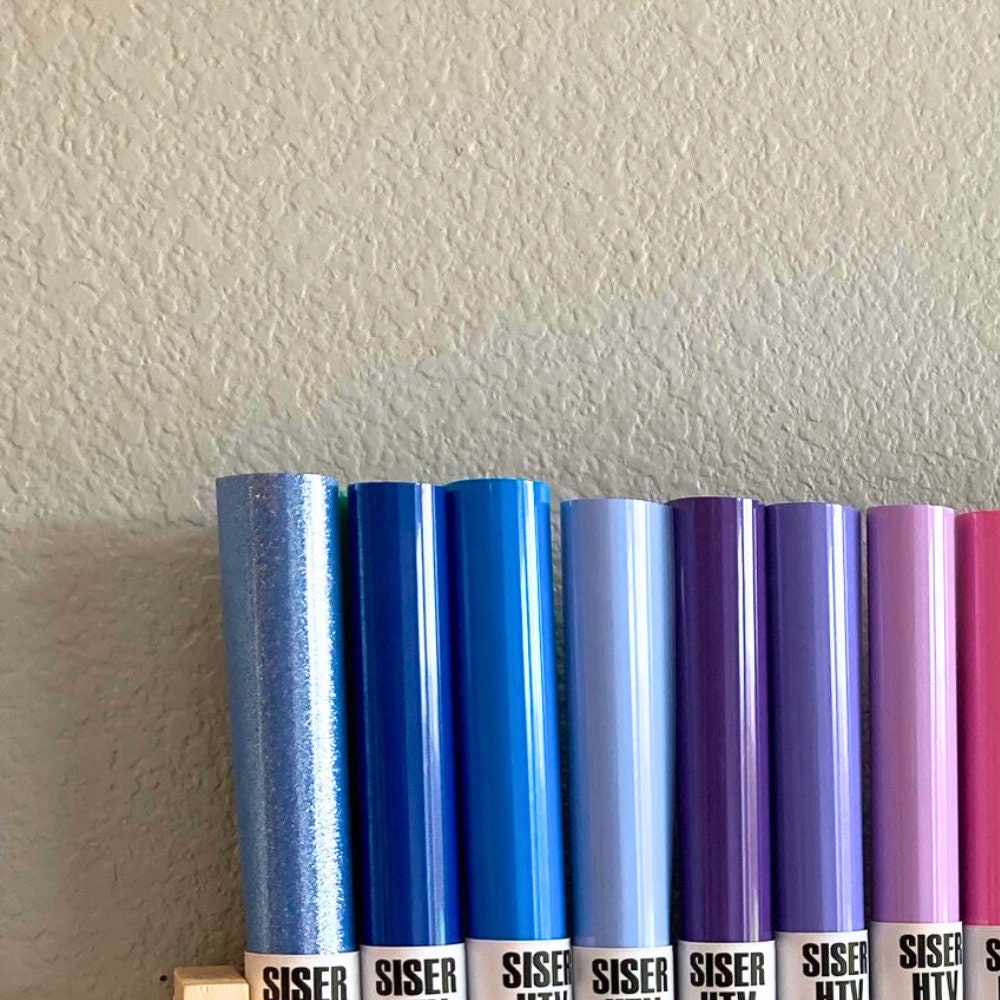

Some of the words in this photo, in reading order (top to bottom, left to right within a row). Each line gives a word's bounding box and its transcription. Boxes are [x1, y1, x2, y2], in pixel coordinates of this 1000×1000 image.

[803, 941, 868, 977] SISER
[900, 932, 963, 969] SISER
[376, 957, 457, 996] SISER
[592, 957, 668, 994] SISER
[690, 952, 765, 988] SISER
